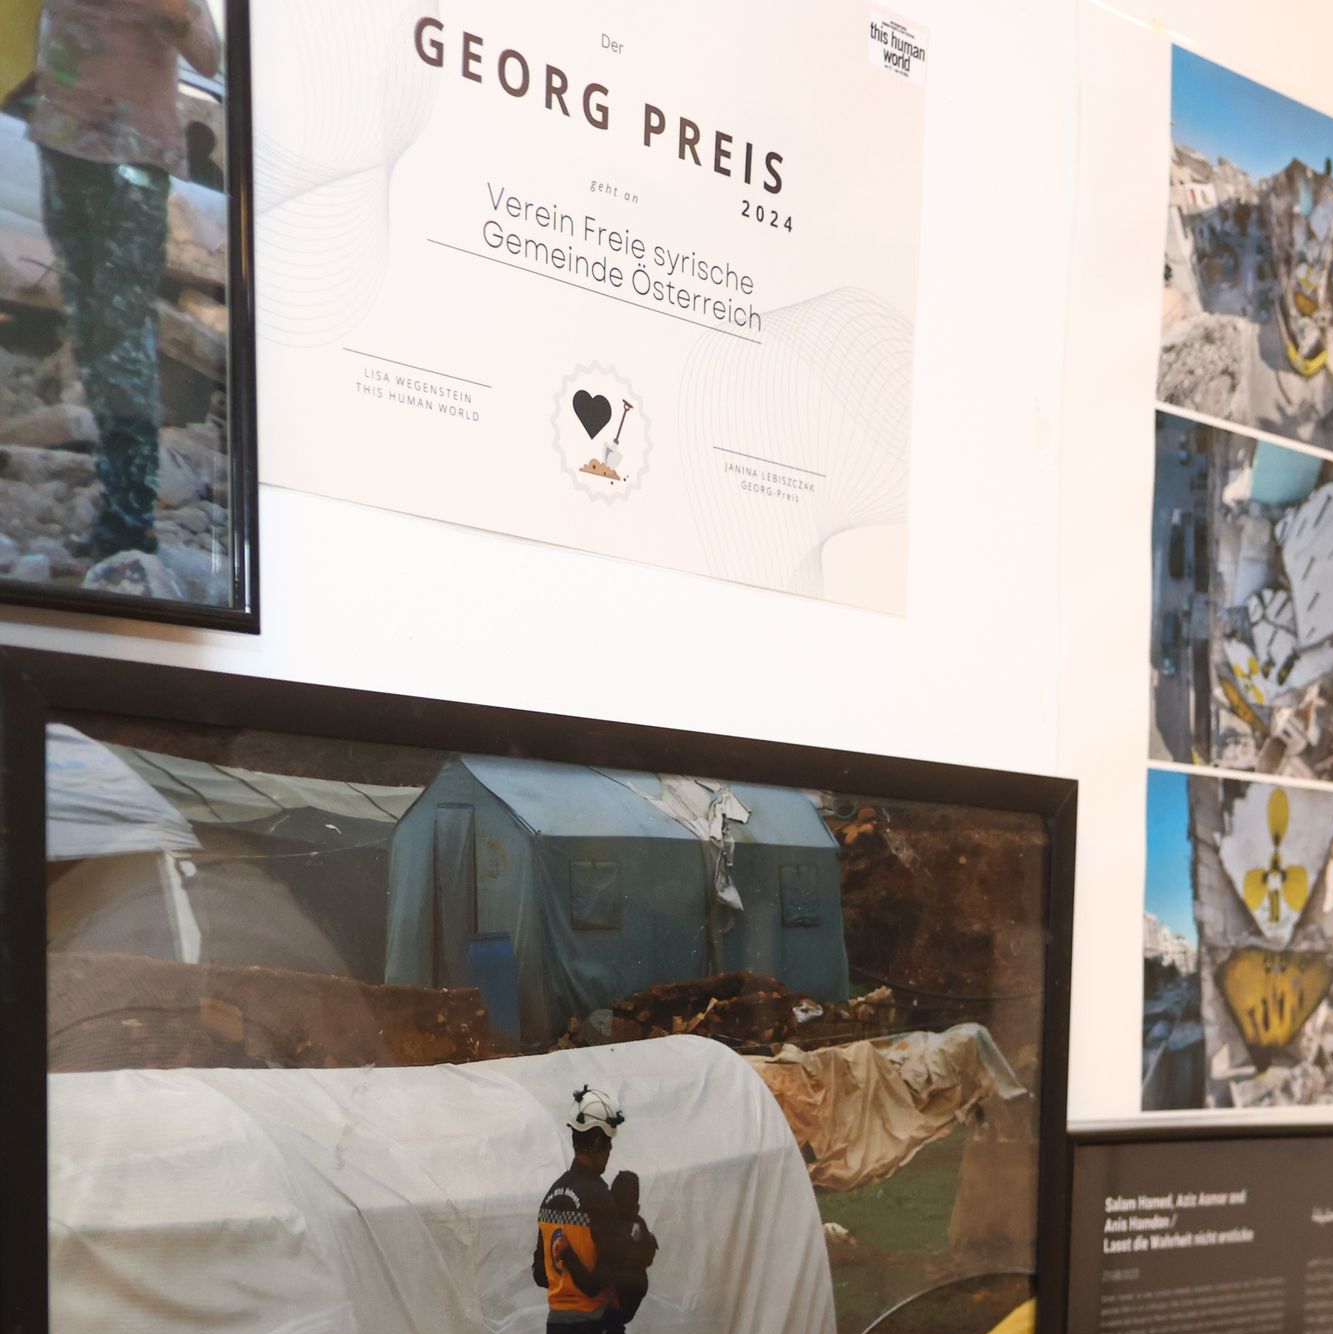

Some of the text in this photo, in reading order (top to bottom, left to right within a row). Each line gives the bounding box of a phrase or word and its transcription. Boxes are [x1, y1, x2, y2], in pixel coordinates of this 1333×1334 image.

[601, 33, 624, 55] Der
[870, 22, 889, 45] this
[891, 32, 926, 62] human
[883, 48, 911, 72] world
[414, 16, 784, 195] GEORG PREIS
[590, 180, 639, 204] geht an
[741, 199, 793, 233] 2024
[487, 182, 754, 295] Verein Freie syrische
[482, 220, 763, 332] Gemeinde Österreich
[356, 382, 480, 422] THIS HUMAN WORLD
[364, 367, 472, 403] LISA WEGENSTEIN
[724, 462, 758, 477] JANINA
